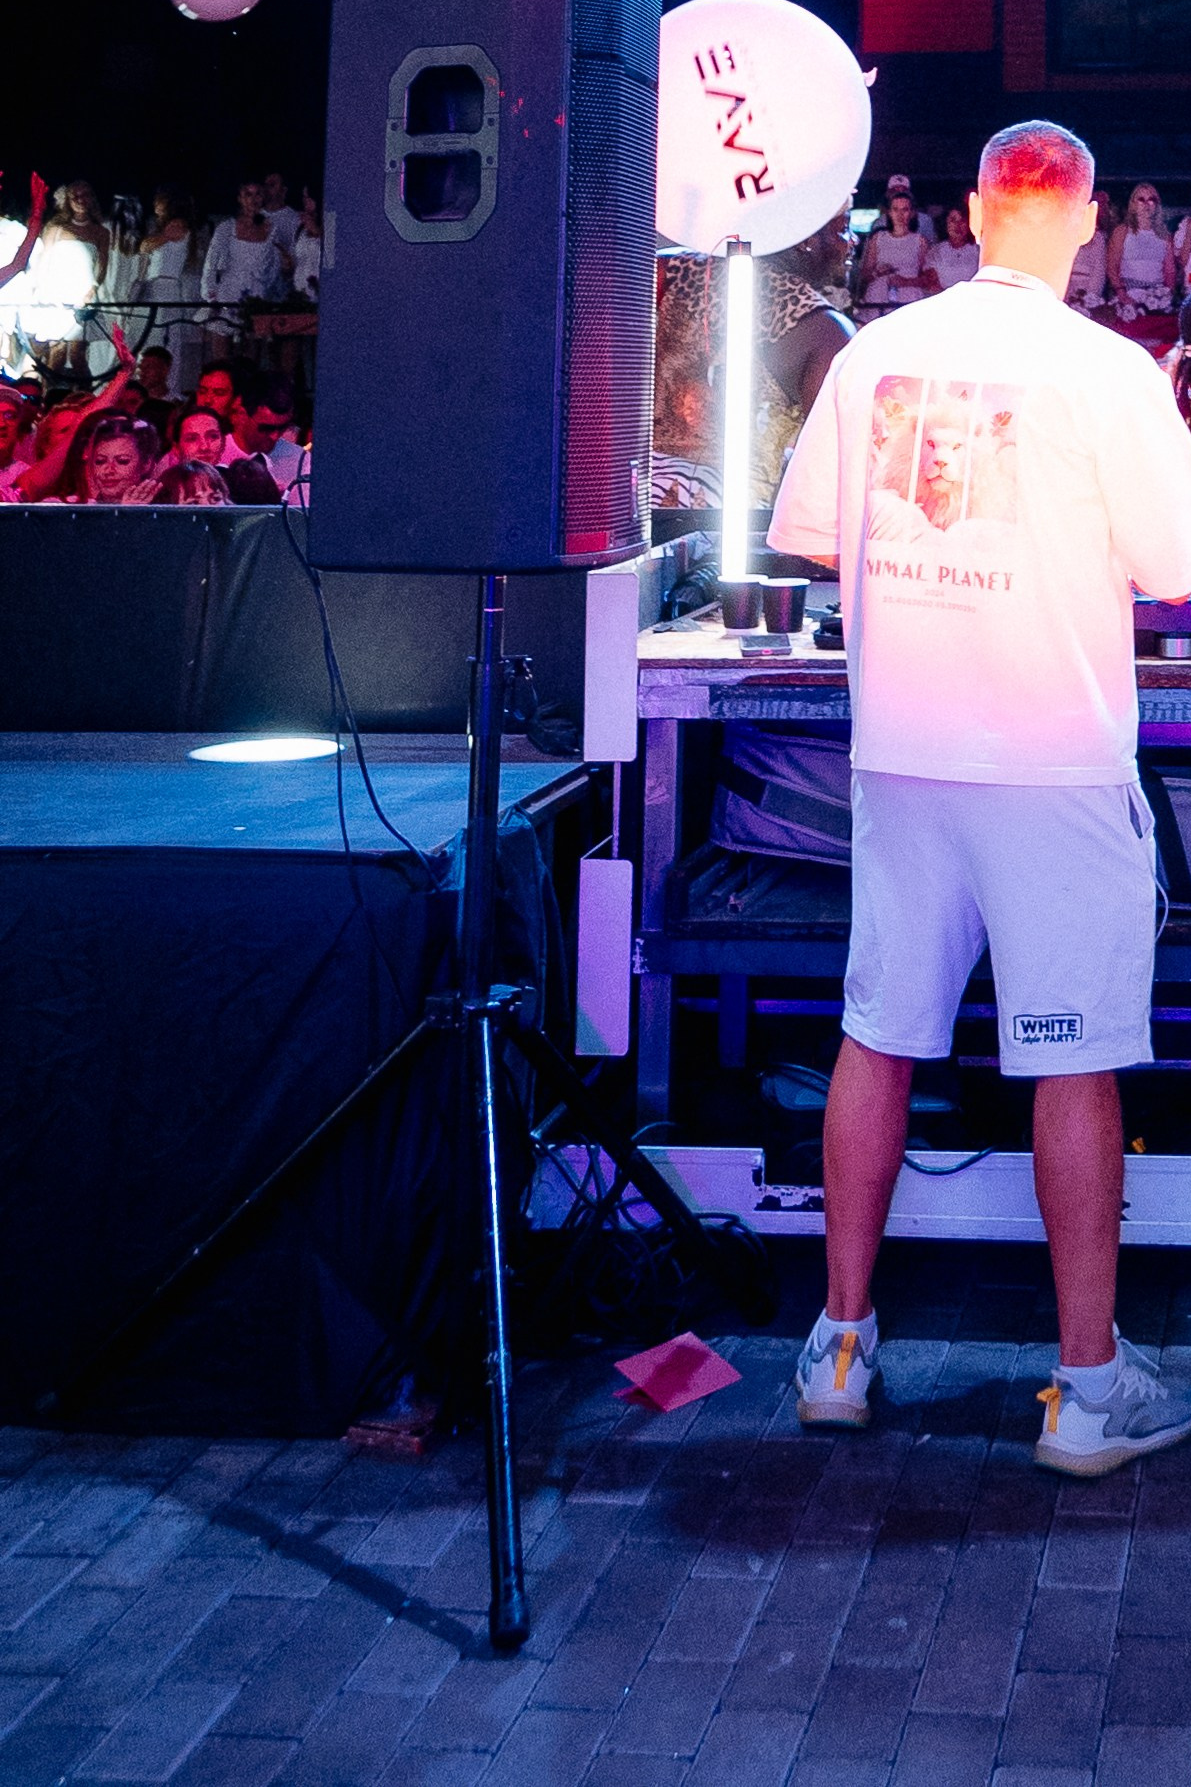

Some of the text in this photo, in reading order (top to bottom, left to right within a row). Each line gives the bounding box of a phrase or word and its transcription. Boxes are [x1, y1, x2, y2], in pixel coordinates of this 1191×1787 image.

[694, 44, 774, 200] RAVE
[866, 558, 1014, 591] NIMAL PLANET
[1020, 1018, 1077, 1034] WHITE
[1043, 1033, 1077, 1043] PARTY
